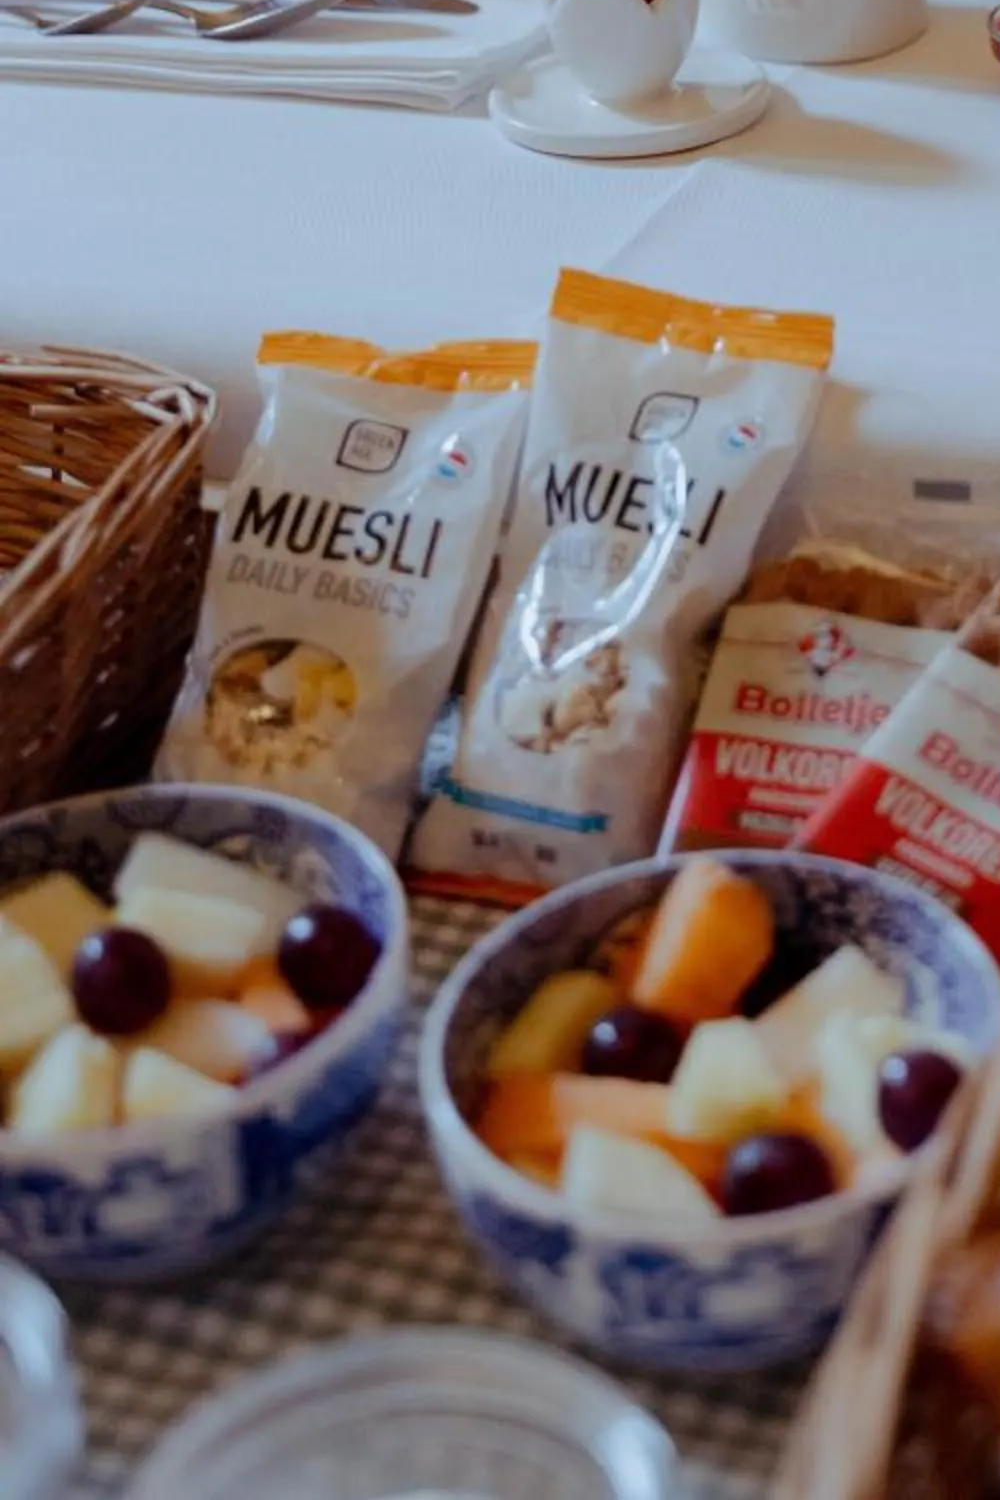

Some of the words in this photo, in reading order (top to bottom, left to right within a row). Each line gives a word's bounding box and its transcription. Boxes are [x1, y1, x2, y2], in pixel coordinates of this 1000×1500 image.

[231, 486, 443, 578] MUESLI
[226, 553, 310, 595] DAILY
[313, 569, 417, 620] BASICS
[715, 736, 856, 788] VOLKOR
